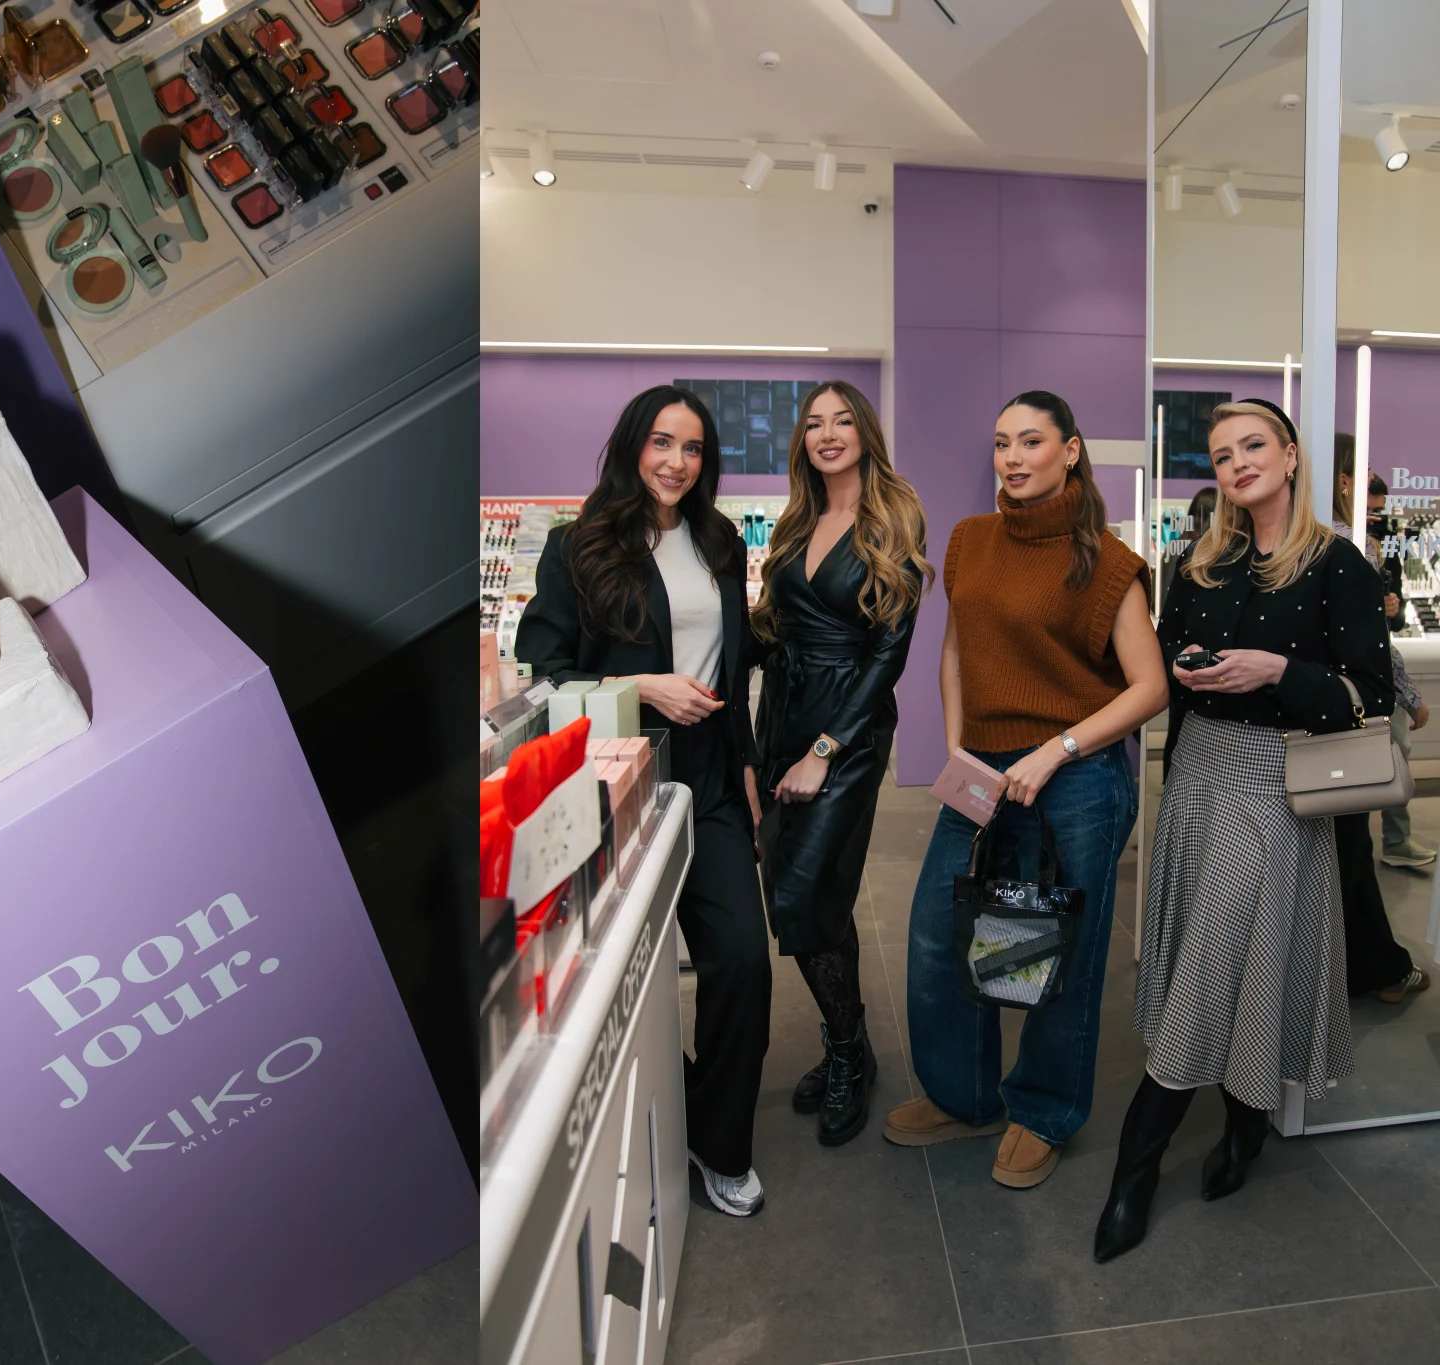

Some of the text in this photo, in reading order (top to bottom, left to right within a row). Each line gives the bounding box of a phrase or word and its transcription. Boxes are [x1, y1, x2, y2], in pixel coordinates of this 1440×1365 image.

[1169, 507, 1194, 533] Bon
[1390, 467, 1440, 490] Bon
[995, 887, 1025, 899] KIKO
[17, 892, 259, 1037] Bon
[40, 949, 280, 1110] jour.
[566, 920, 652, 1172] SPECIAL OFFER
[103, 1035, 323, 1174] KIKO
[179, 1096, 273, 1155] MILANO
